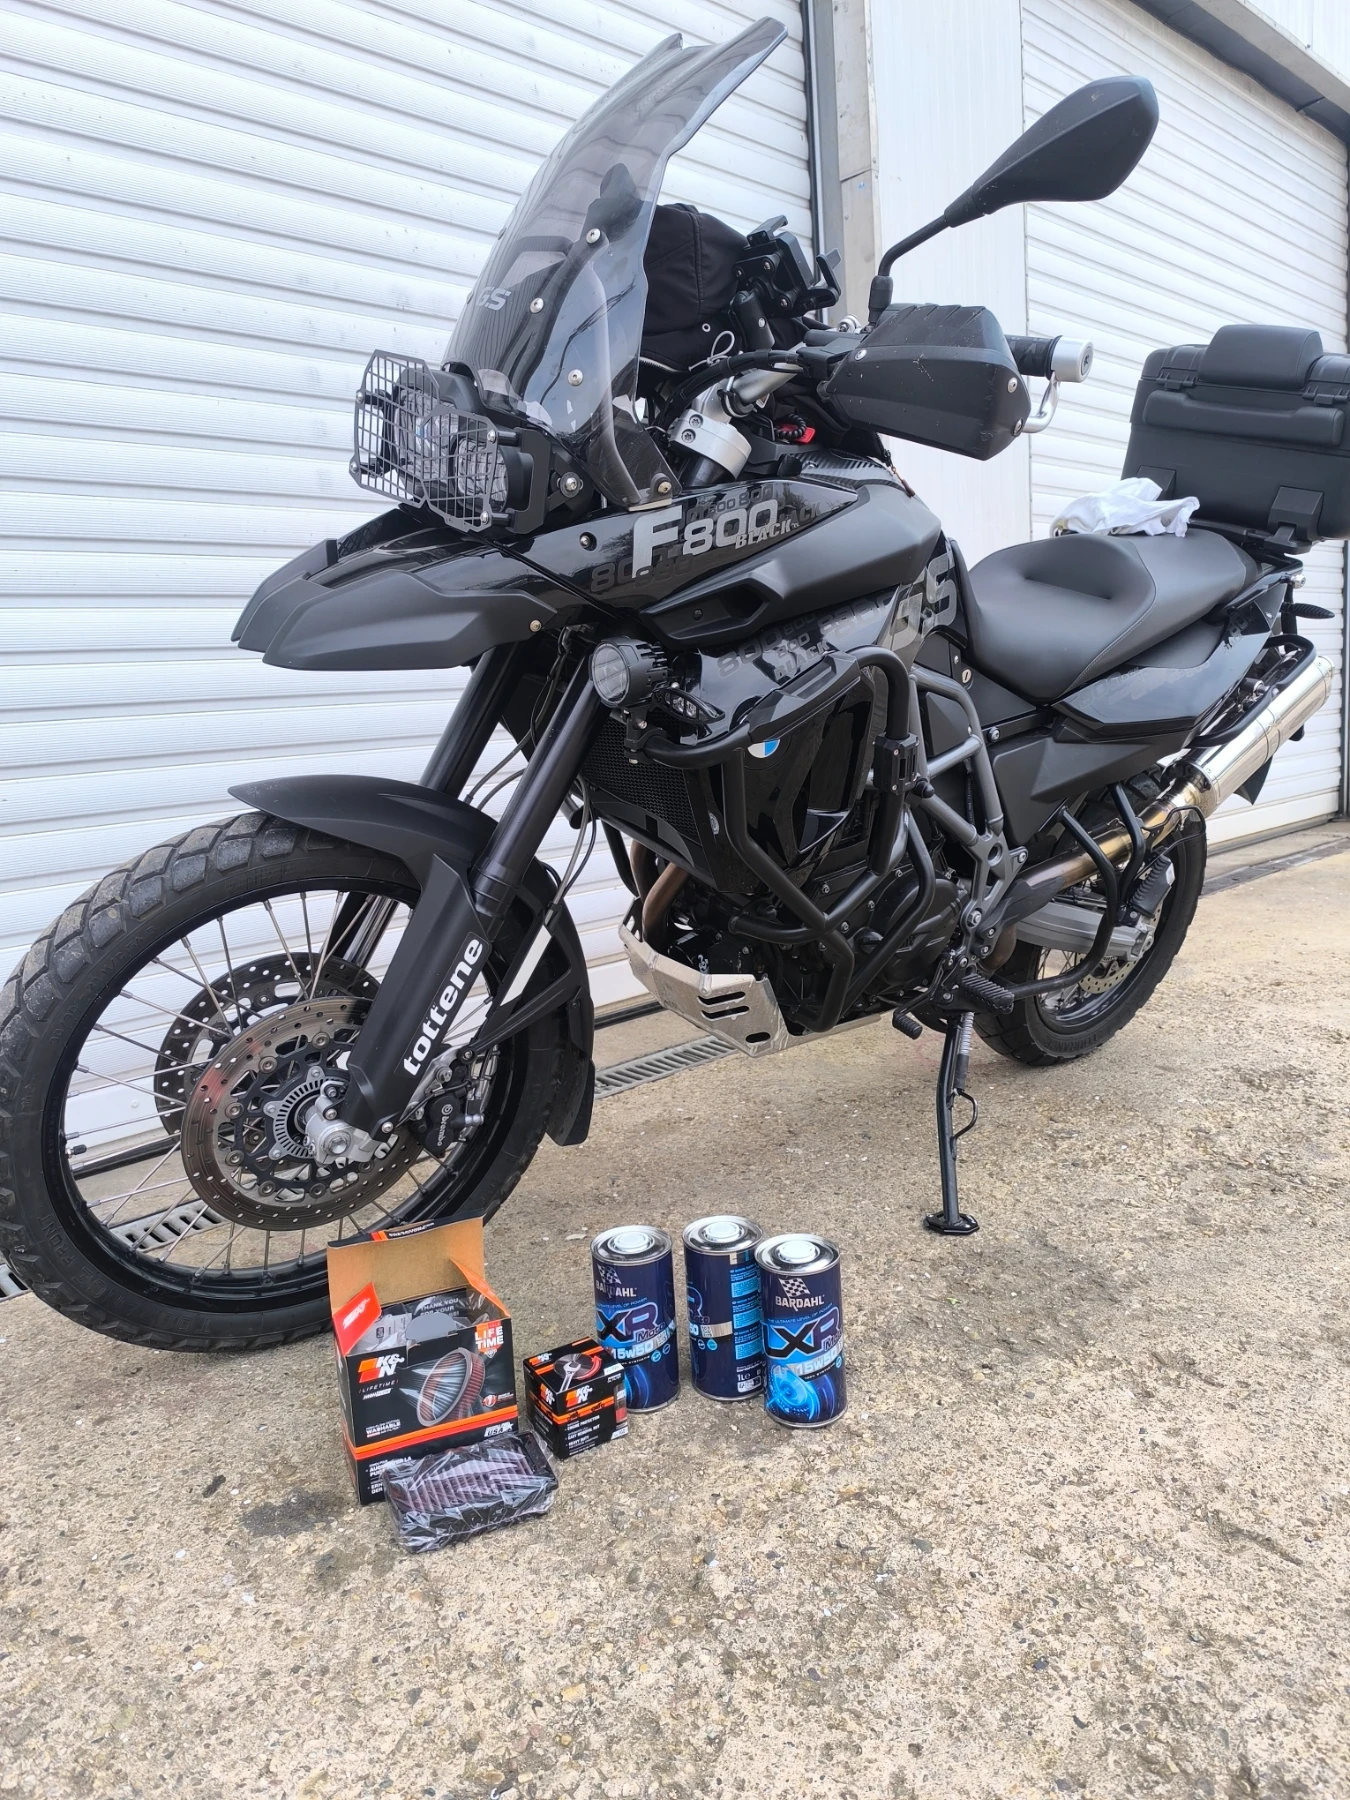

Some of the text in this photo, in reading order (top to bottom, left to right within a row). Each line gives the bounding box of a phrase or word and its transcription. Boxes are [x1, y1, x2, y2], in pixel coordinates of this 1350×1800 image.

[735, 518, 792, 550] BLACK
[437, 1115, 450, 1147] brembo
[444, 1297, 459, 1306] YOU
[775, 1294, 825, 1312] BARDAHL
[475, 1325, 504, 1341] LIFE
[475, 1335, 505, 1350] TIME
[362, 1380, 396, 1393] LIFETIME
